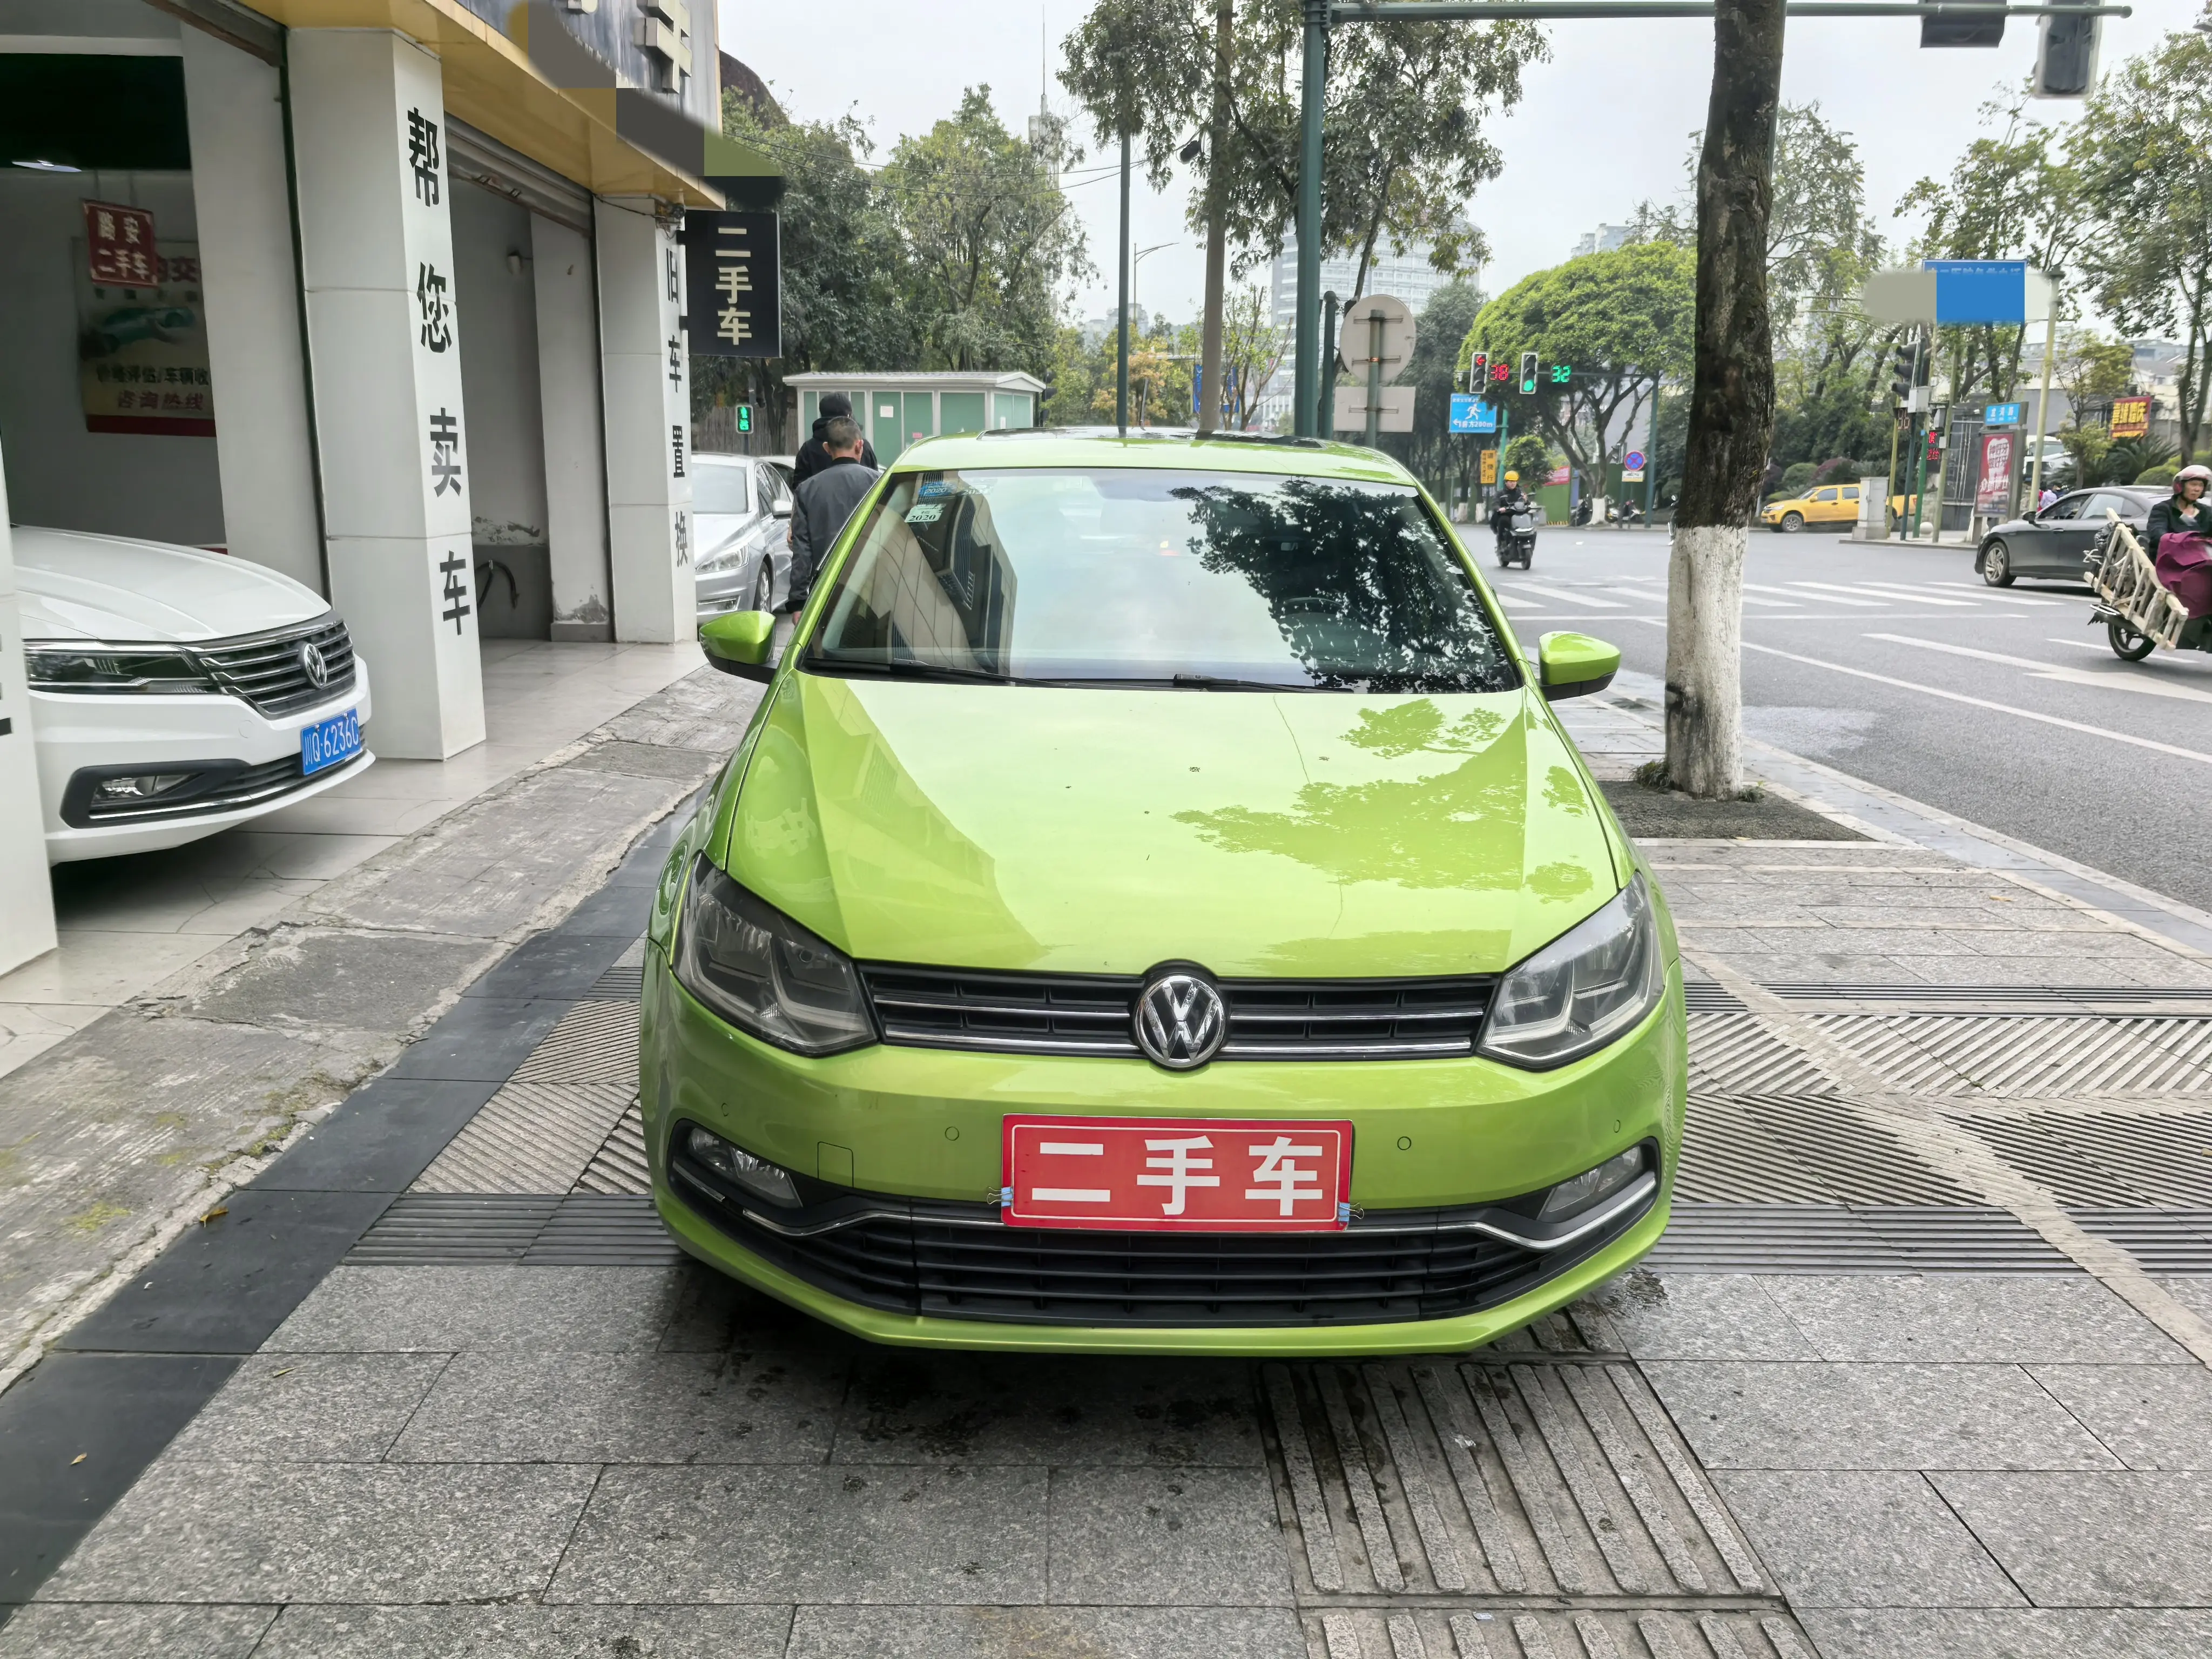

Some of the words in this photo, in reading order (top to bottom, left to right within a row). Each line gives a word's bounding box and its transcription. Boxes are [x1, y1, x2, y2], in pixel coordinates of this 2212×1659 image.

[97, 248, 150, 280] 二手车
[716, 227, 752, 345] 二手车
[408, 107, 471, 636] 帮您卖车
[666, 247, 687, 567] 旧车置换
[1552, 365, 1572, 382] 32
[1032, 1135, 1323, 1216] 二手车
